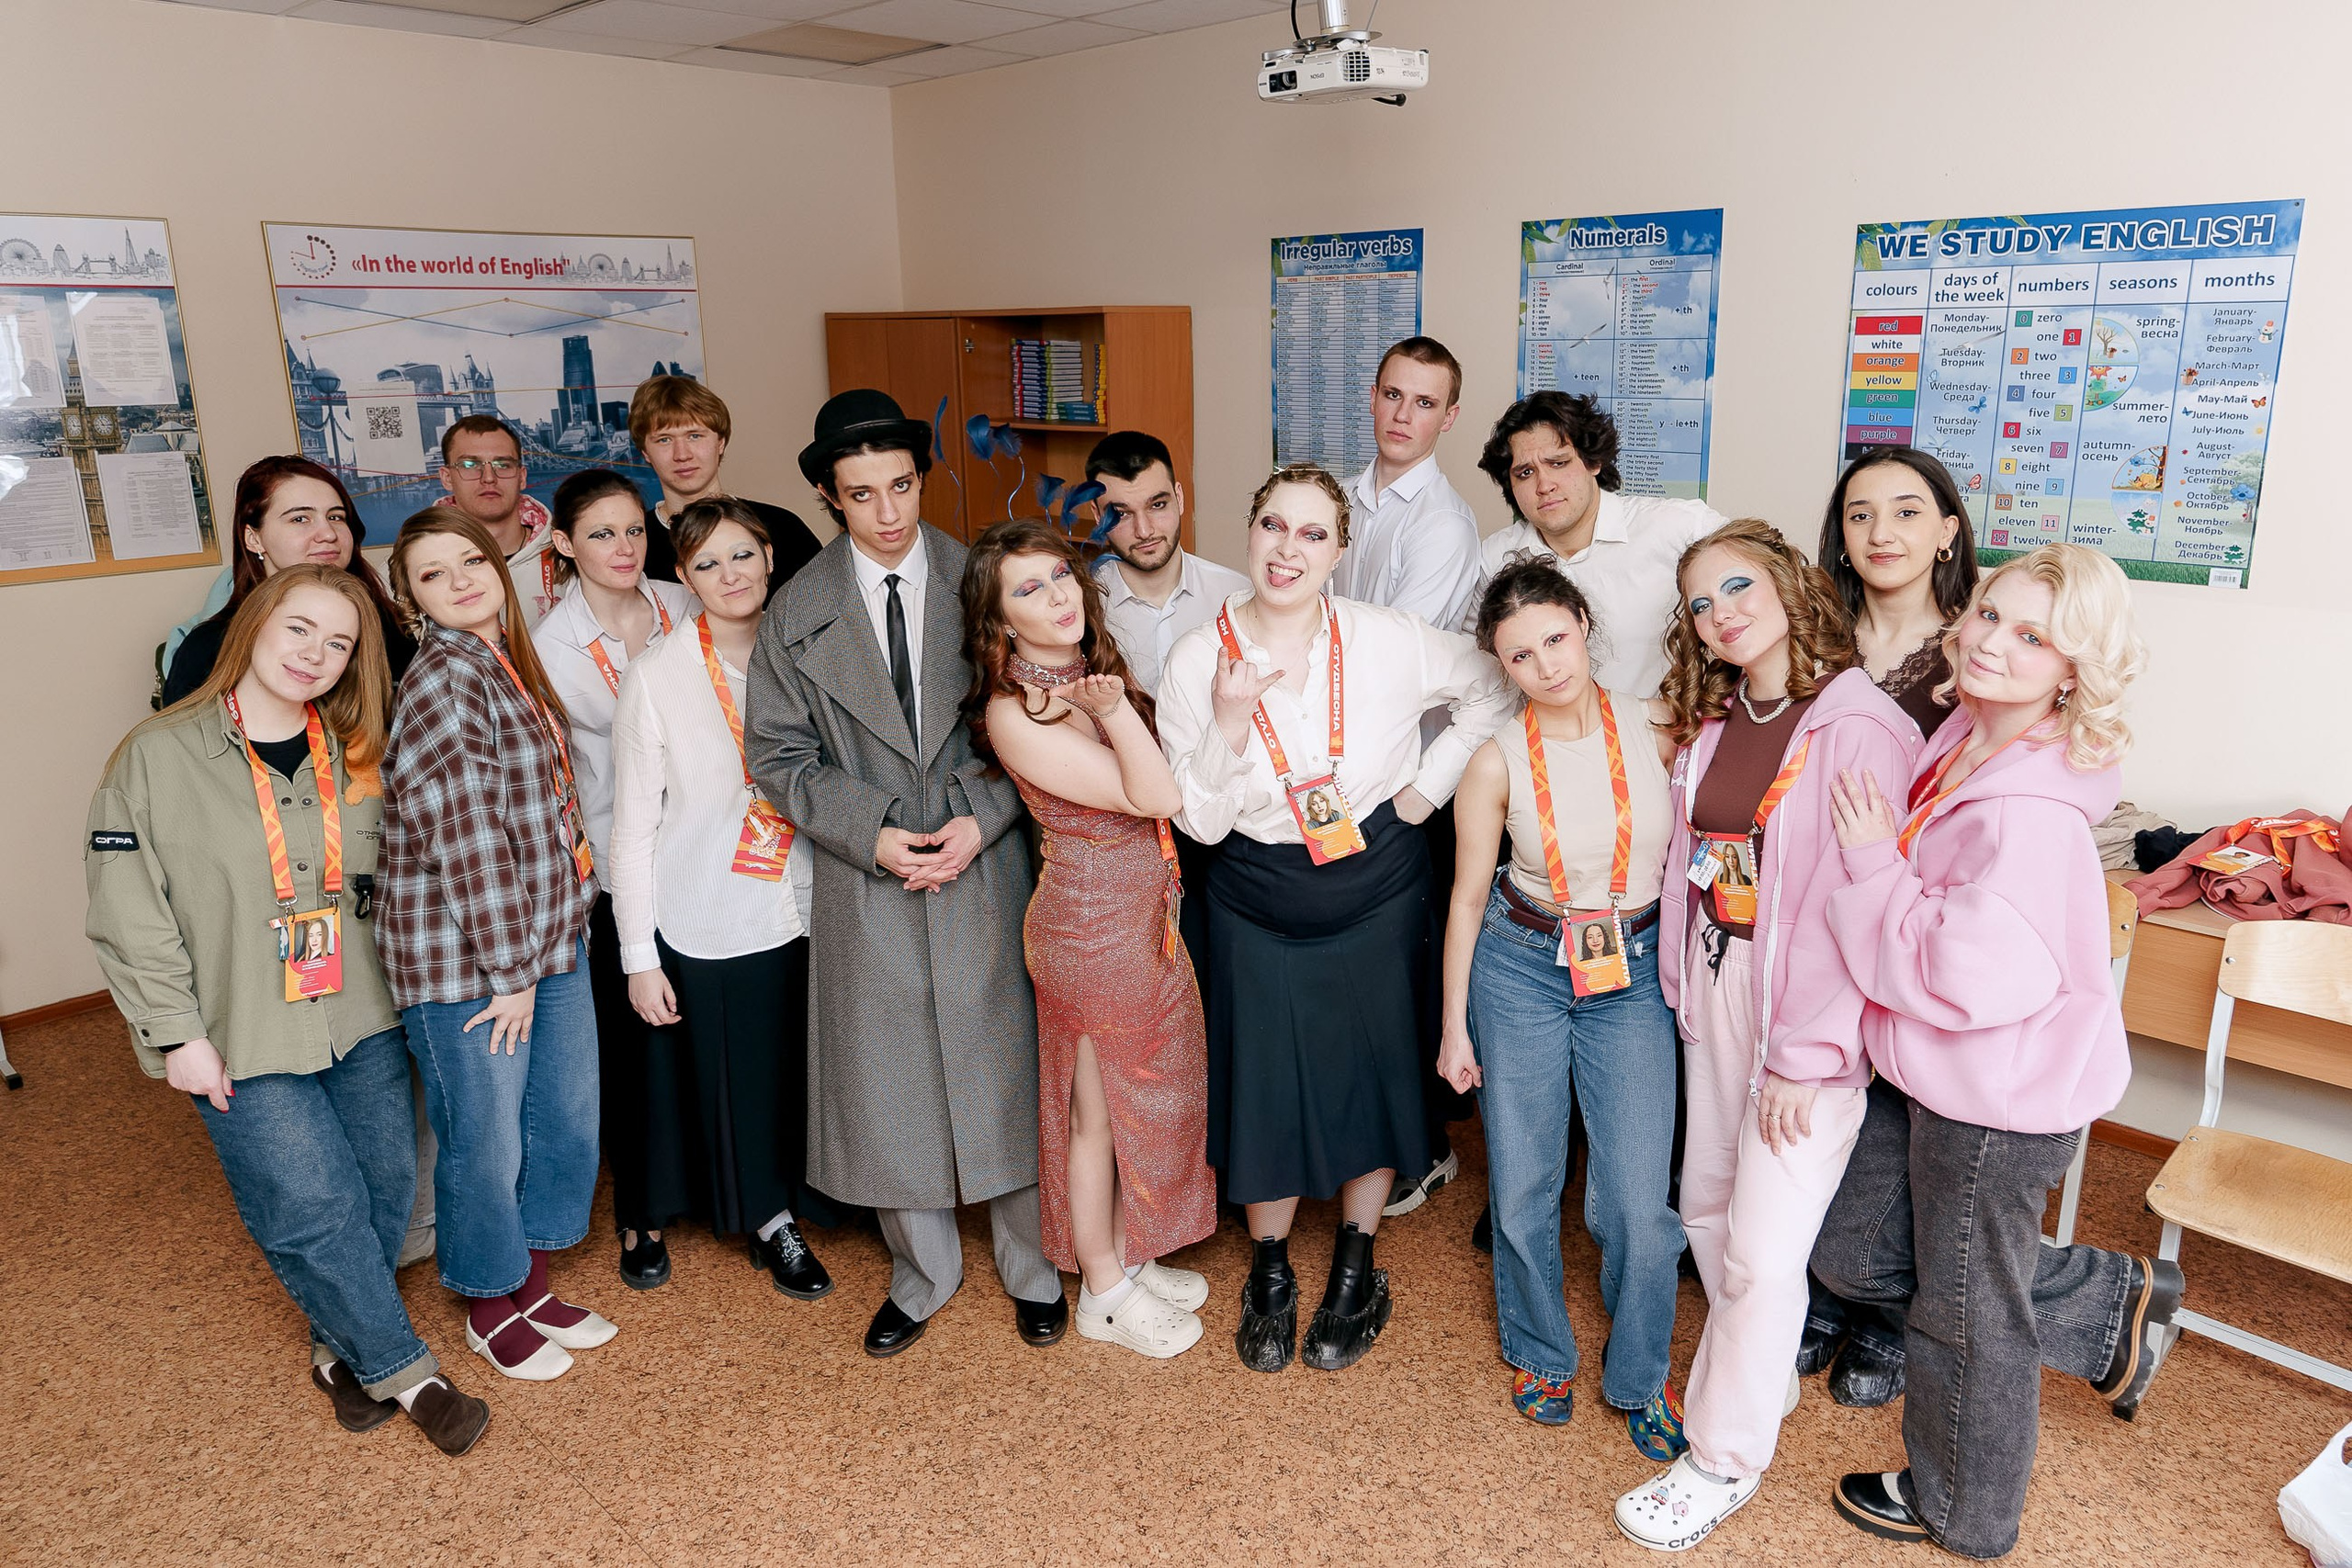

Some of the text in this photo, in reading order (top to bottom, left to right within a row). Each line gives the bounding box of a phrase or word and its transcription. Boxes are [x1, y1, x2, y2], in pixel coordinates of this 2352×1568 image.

[1570, 223, 1667, 250] Numerals
[1877, 214, 2277, 260] WE STUDY ENGLISH
[1281, 235, 1413, 262] Irregular verbs
[385, 254, 416, 273] the
[421, 256, 474, 275] world
[479, 256, 496, 275] of
[1304, 262, 1355, 271] Неправильные
[1649, 258, 1676, 266] Ordinal
[1944, 272, 1999, 289] days of
[2018, 277, 2089, 292] numbers
[2109, 276, 2177, 290] seasons
[2205, 272, 2275, 288] months
[1866, 283, 1917, 297] colours
[1935, 288, 2004, 302] the week
[1682, 306, 1692, 314] th
[2213, 308, 2256, 318] January-
[1944, 313, 1990, 324] Monday-
[2020, 314, 2062, 323] 0 zero
[2136, 316, 2180, 328] spring-
[2214, 318, 2254, 326] Январь
[1879, 320, 1898, 332] red
[1930, 323, 2002, 334] Понедельник
[2037, 333, 2075, 343] one 1
[2141, 329, 2178, 339] весна
[2206, 334, 2256, 344] February-
[1871, 339, 1903, 350] white
[2206, 344, 2253, 355] Февраль
[1942, 348, 1986, 359] Tuesday-
[2017, 352, 2057, 361] 2 two
[1866, 356, 1905, 367] orange
[1941, 357, 1984, 367] Вторник
[2195, 362, 2260, 371] March-Март
[2020, 370, 2071, 380] three 3
[1866, 376, 1902, 387] yellow
[2191, 378, 2259, 389] April-Апрель
[1930, 382, 1991, 392] Wednesday-
[1866, 393, 1898, 404] green
[1943, 392, 1975, 402] Среда
[2012, 389, 2056, 399] 4 four
[2197, 395, 2248, 404] May-Май
[2113, 402, 2169, 412] summer-
[1868, 412, 1893, 423] blue
[2029, 408, 2066, 418] five 5
[2191, 412, 2249, 421] June-Июнь
[1933, 416, 1981, 427] Thursday-
[2137, 414, 2167, 423] лето
[1936, 425, 1976, 436] Четверг
[2008, 425, 2041, 435] 6 six
[2191, 426, 2245, 436] July-Июль
[1860, 430, 1897, 442] purple
[2055, 446, 2062, 455] 7
[2083, 441, 2135, 450] autumn-
[2197, 442, 2235, 452] August-
[1937, 448, 1971, 460] Friday-
[2082, 453, 2119, 462] осень
[2198, 451, 2232, 460] Август
[2005, 462, 2051, 474] 8 eight
[2184, 467, 2242, 477] September-
[2187, 476, 2235, 486] Сентябрь
[2015, 482, 2057, 491] nine 9
[2187, 491, 2231, 502] October-
[1998, 498, 2038, 508] 10 ten
[2186, 501, 2229, 511] Октябрь
[1998, 516, 2056, 528] eleven 11
[2177, 516, 2233, 526] November-
[2073, 524, 2117, 535] winter-
[2185, 525, 2223, 536] Ноябрь
[1994, 534, 2052, 546] 12 twelve
[2072, 536, 2103, 546] зима
[2175, 541, 2229, 551] December-
[2177, 550, 2222, 560] Декабрь
[1668, 1516, 1718, 1549] crocs
